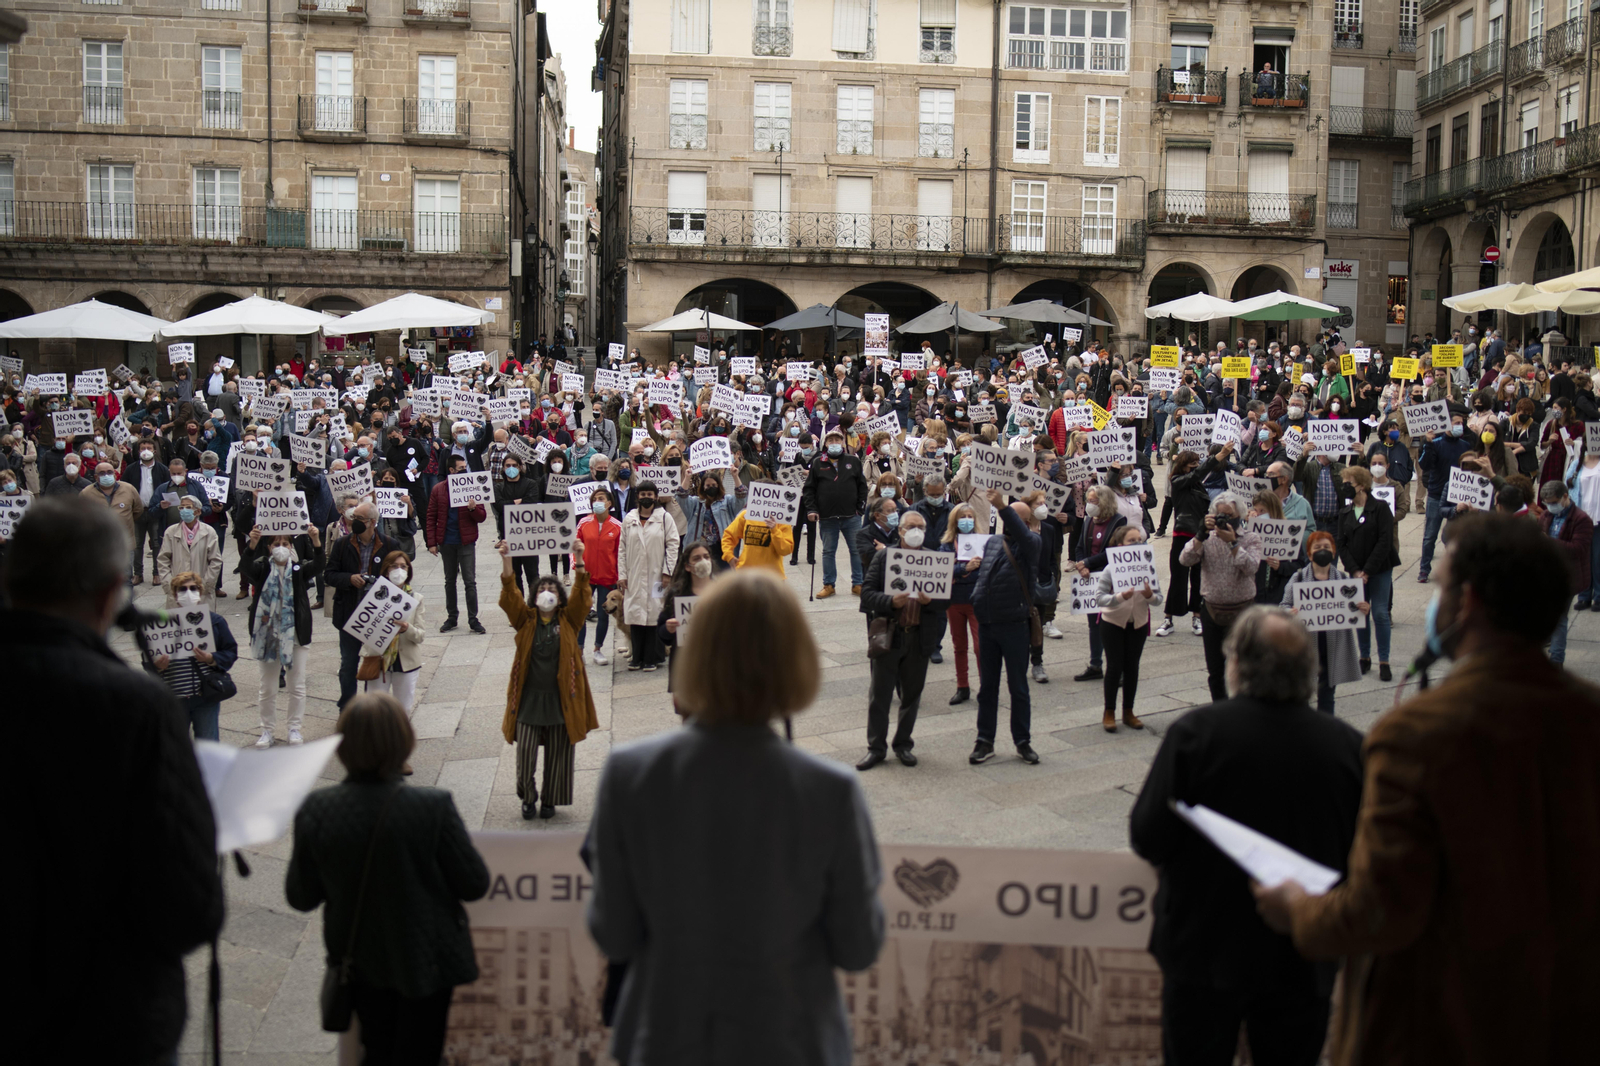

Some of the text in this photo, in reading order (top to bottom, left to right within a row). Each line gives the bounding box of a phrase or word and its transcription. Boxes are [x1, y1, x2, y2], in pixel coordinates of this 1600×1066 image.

[1329, 261, 1352, 273] Nikis
[454, 393, 474, 402] NON
[716, 388, 732, 397] NON
[1019, 406, 1034, 415] NON
[1406, 406, 1428, 417] NON
[868, 420, 887, 431] NON
[1312, 424, 1338, 433] NON
[1420, 424, 1438, 433] UPO
[1183, 428, 1202, 437] NON
[1287, 431, 1303, 442] NON
[291, 438, 309, 449] NON
[1092, 433, 1118, 445] NON
[692, 440, 713, 454] NON
[1324, 444, 1345, 452] UPO
[701, 450, 720, 458] PECHE
[976, 448, 1006, 466] NON
[1106, 454, 1125, 463] UPO
[240, 458, 267, 471] NON
[299, 456, 314, 465] UPO
[702, 458, 721, 468] UPO
[250, 471, 274, 480] PECHE
[641, 470, 663, 478] NON
[986, 466, 1015, 478] PECHE
[331, 473, 356, 486] NON
[452, 477, 474, 486] NON
[1069, 473, 1087, 482] UPO
[1452, 472, 1474, 484] NON
[250, 481, 272, 490] UPO
[344, 478, 363, 489] PECHE
[974, 478, 1012, 491] DA UPO
[1229, 477, 1250, 491] NON
[573, 486, 594, 496] NON
[753, 487, 780, 499] NON
[1460, 484, 1479, 494] PECHE
[260, 497, 289, 508] NON
[463, 494, 482, 503] UPO
[1459, 495, 1477, 504] UPO
[763, 500, 786, 509] PECHE
[510, 510, 545, 523] NON
[762, 511, 784, 520] UPO
[272, 521, 298, 531] UPO
[525, 526, 556, 534] PECHE
[1253, 522, 1284, 535] NON
[510, 539, 556, 551] DA UPO
[1264, 547, 1286, 557] UPO
[906, 555, 933, 565] UPO
[1113, 551, 1141, 564] NON
[904, 569, 933, 578] PECHE
[1079, 577, 1094, 586] UPO
[1130, 576, 1150, 586] UPO
[912, 580, 946, 593] NON
[1300, 586, 1334, 600] NON
[1315, 601, 1345, 610] PECHE
[351, 601, 378, 634] NON
[364, 602, 393, 640] AO PECHE
[1317, 614, 1345, 626] UPO
[161, 628, 193, 639] PECHE
[375, 610, 403, 648] DA UPO
[164, 641, 194, 655] UPO
